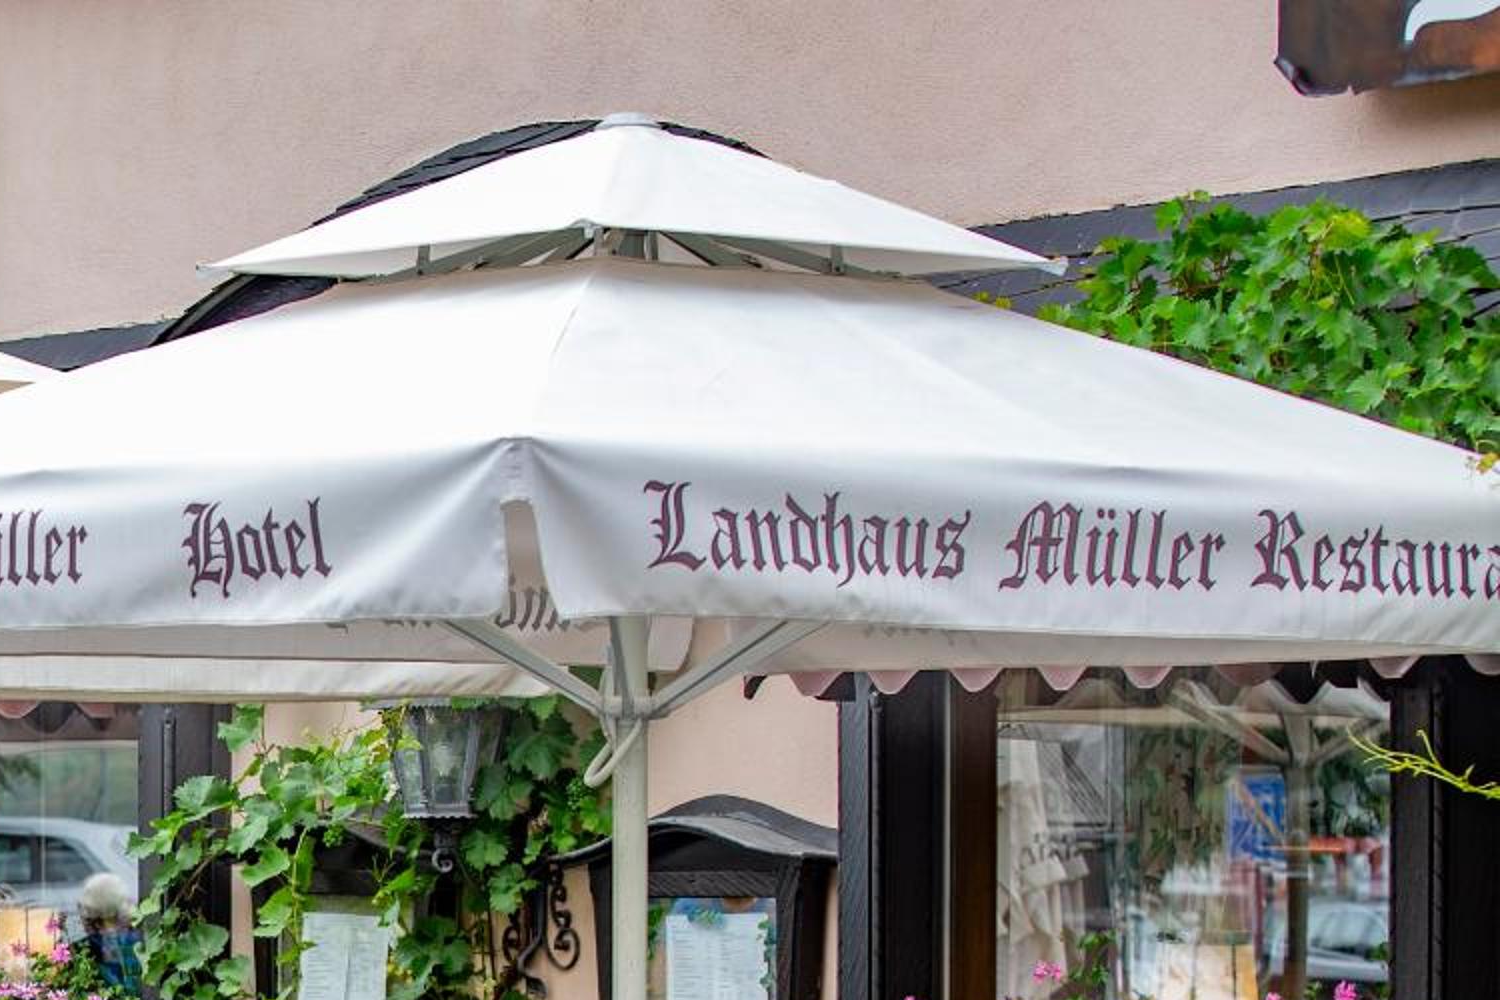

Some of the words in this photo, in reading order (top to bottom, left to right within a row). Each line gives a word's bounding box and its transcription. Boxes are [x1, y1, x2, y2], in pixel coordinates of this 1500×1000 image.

[181, 496, 332, 599] Hotel
[643, 480, 972, 588] Landhaus
[998, 500, 1226, 593] Müller
